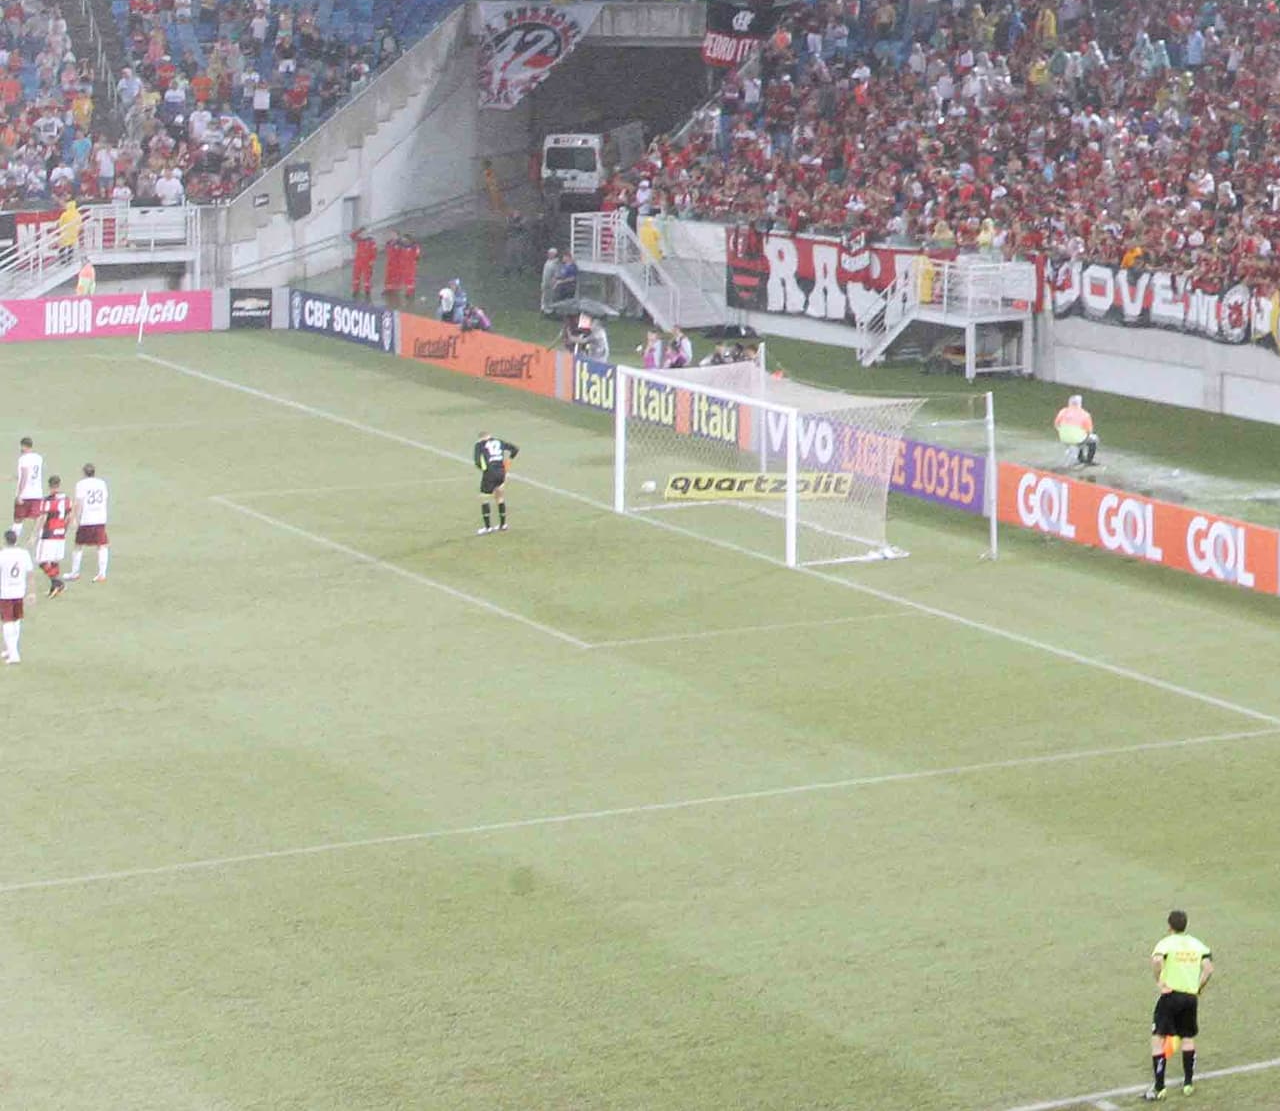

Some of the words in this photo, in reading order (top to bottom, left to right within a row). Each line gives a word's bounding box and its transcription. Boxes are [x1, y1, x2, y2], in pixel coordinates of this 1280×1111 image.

[44, 299, 92, 335] HAJA
[96, 300, 189, 327] CORAÇÃO
[304, 299, 332, 330] CBF
[332, 304, 380, 342] SOCIAL
[574, 360, 615, 408] Itaú
[631, 376, 676, 426] Itaú
[692, 389, 738, 442] Itaú
[912, 446, 975, 505] 10315
[1017, 472, 1076, 539] GOL
[1097, 493, 1163, 562] GOL
[10, 561, 20, 578] 6
[1186, 515, 1255, 588] GOL
